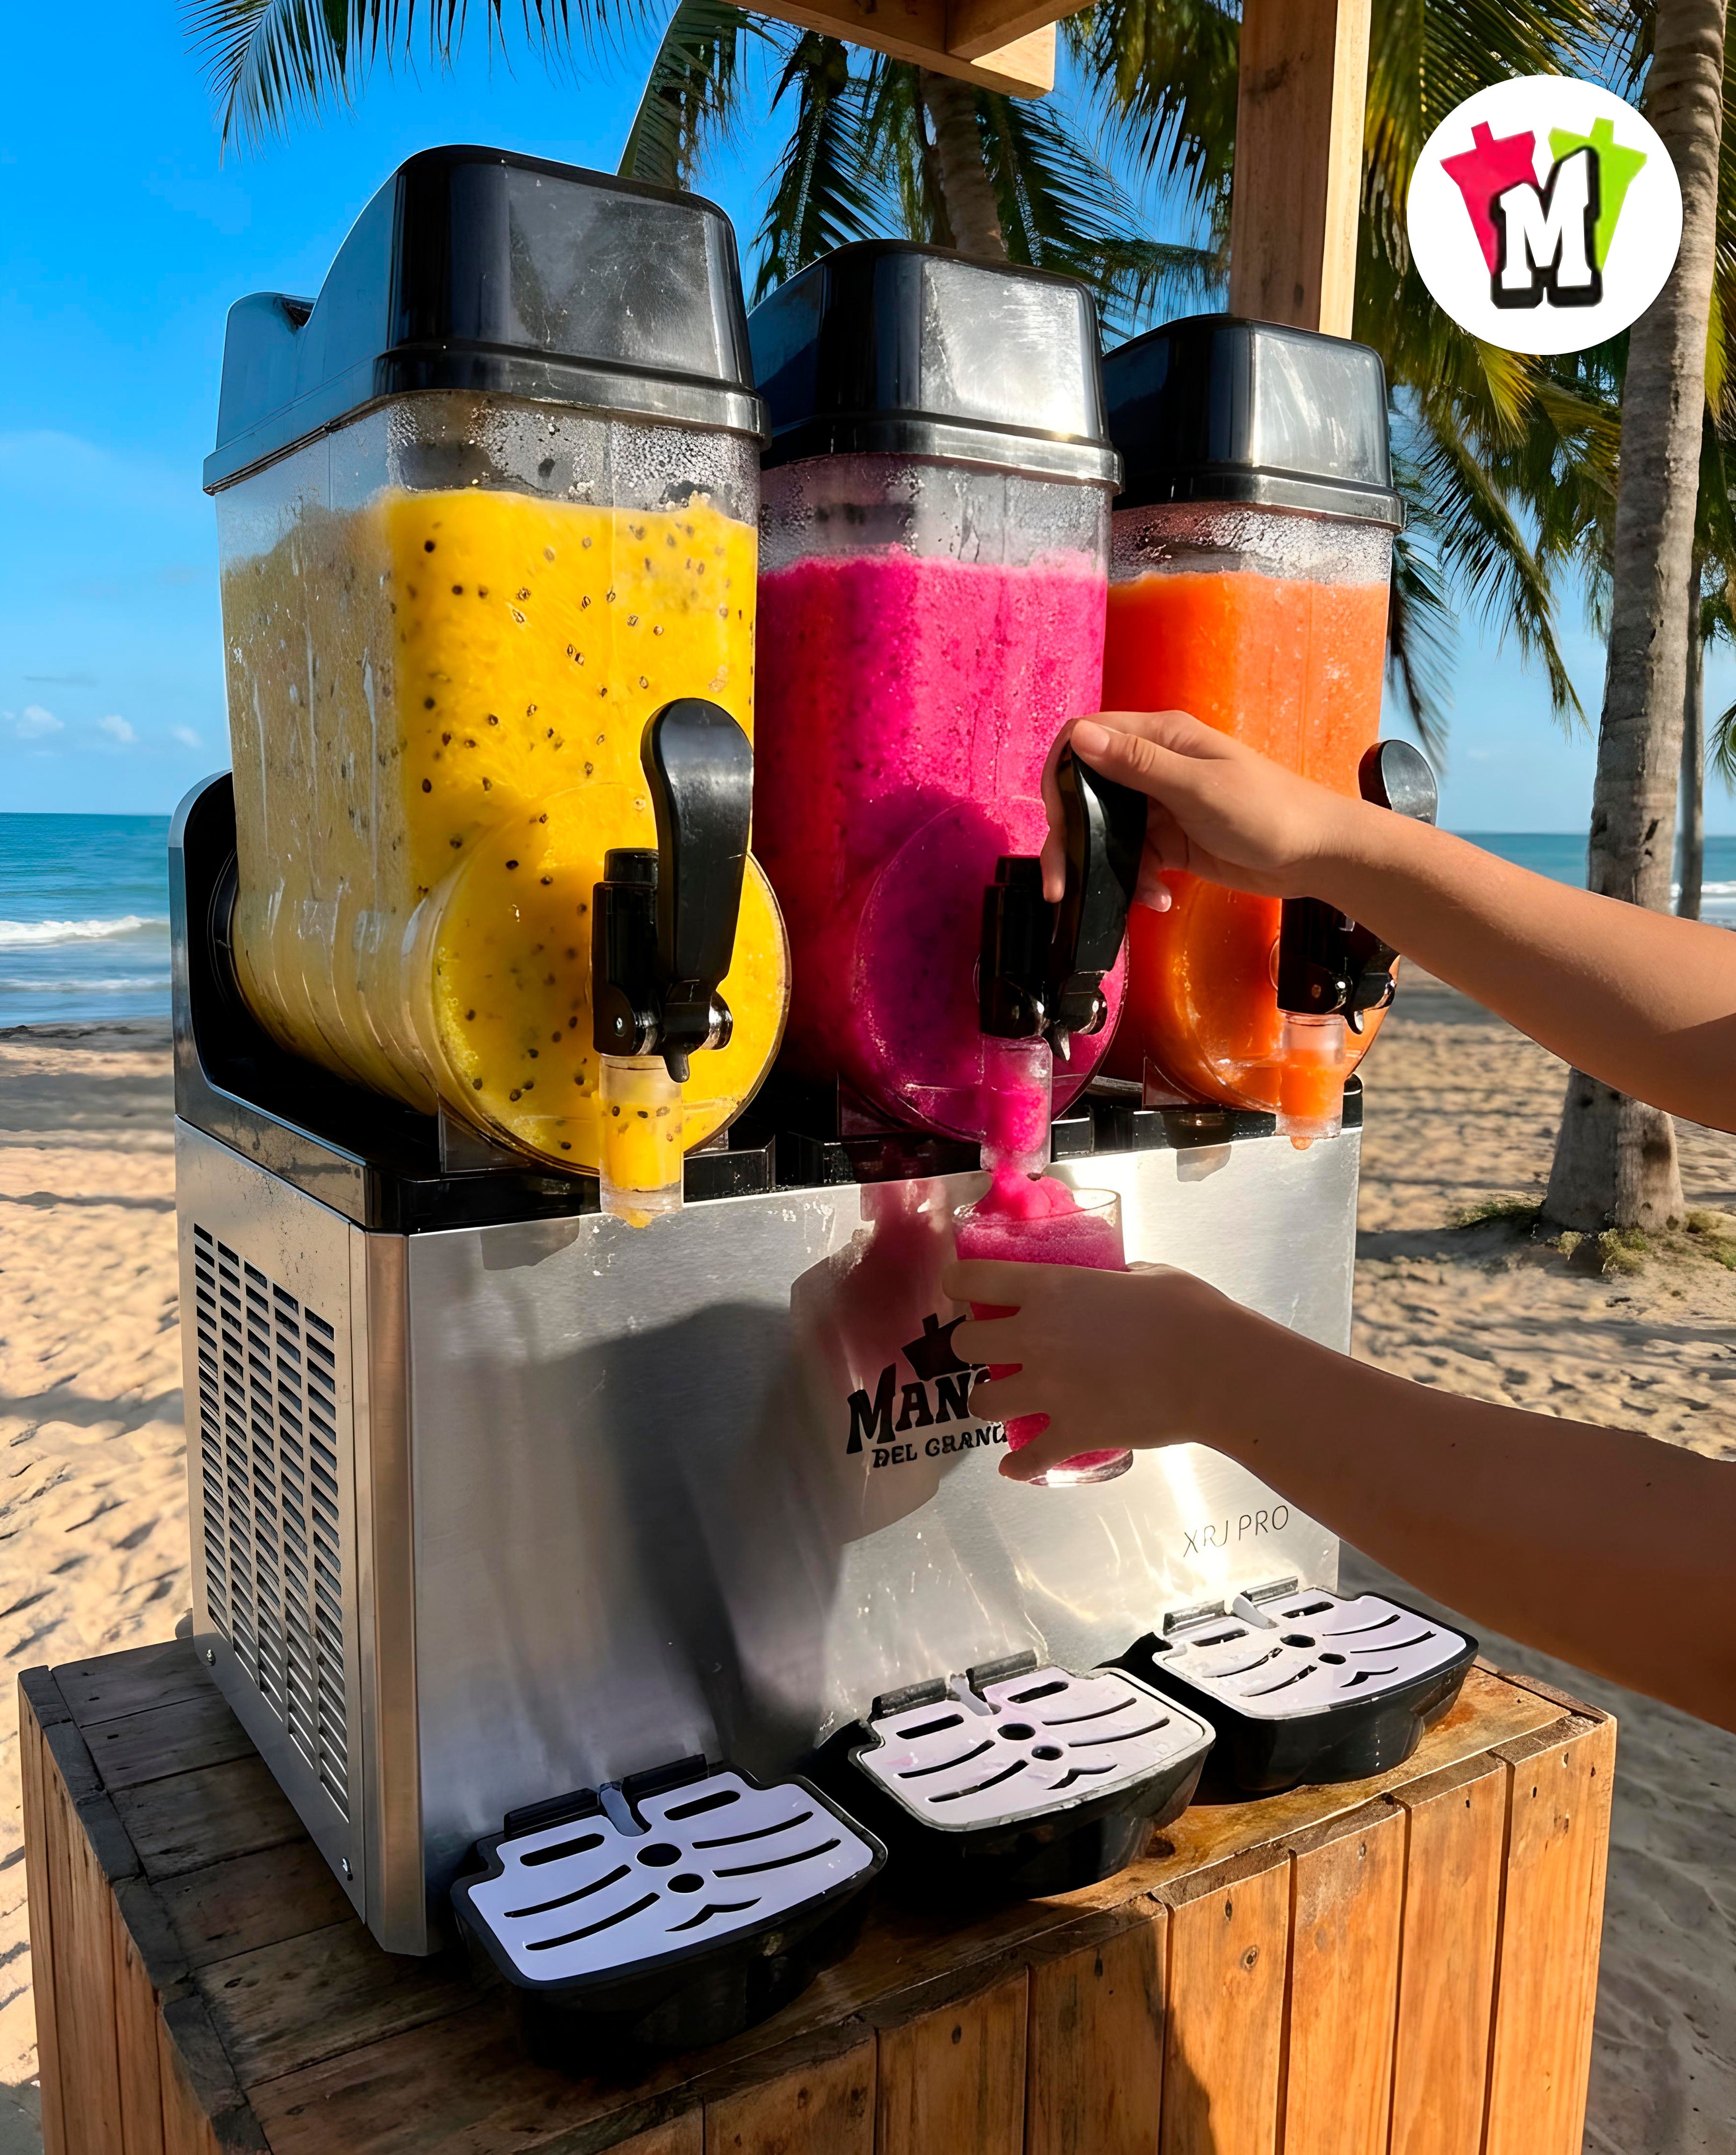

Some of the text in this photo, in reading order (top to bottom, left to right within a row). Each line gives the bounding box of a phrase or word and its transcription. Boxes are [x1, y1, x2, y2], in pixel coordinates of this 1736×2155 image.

[846, 1362, 990, 1454] MAN
[871, 1443, 918, 1468] DEL
[1238, 1505, 1288, 1541] PRO
